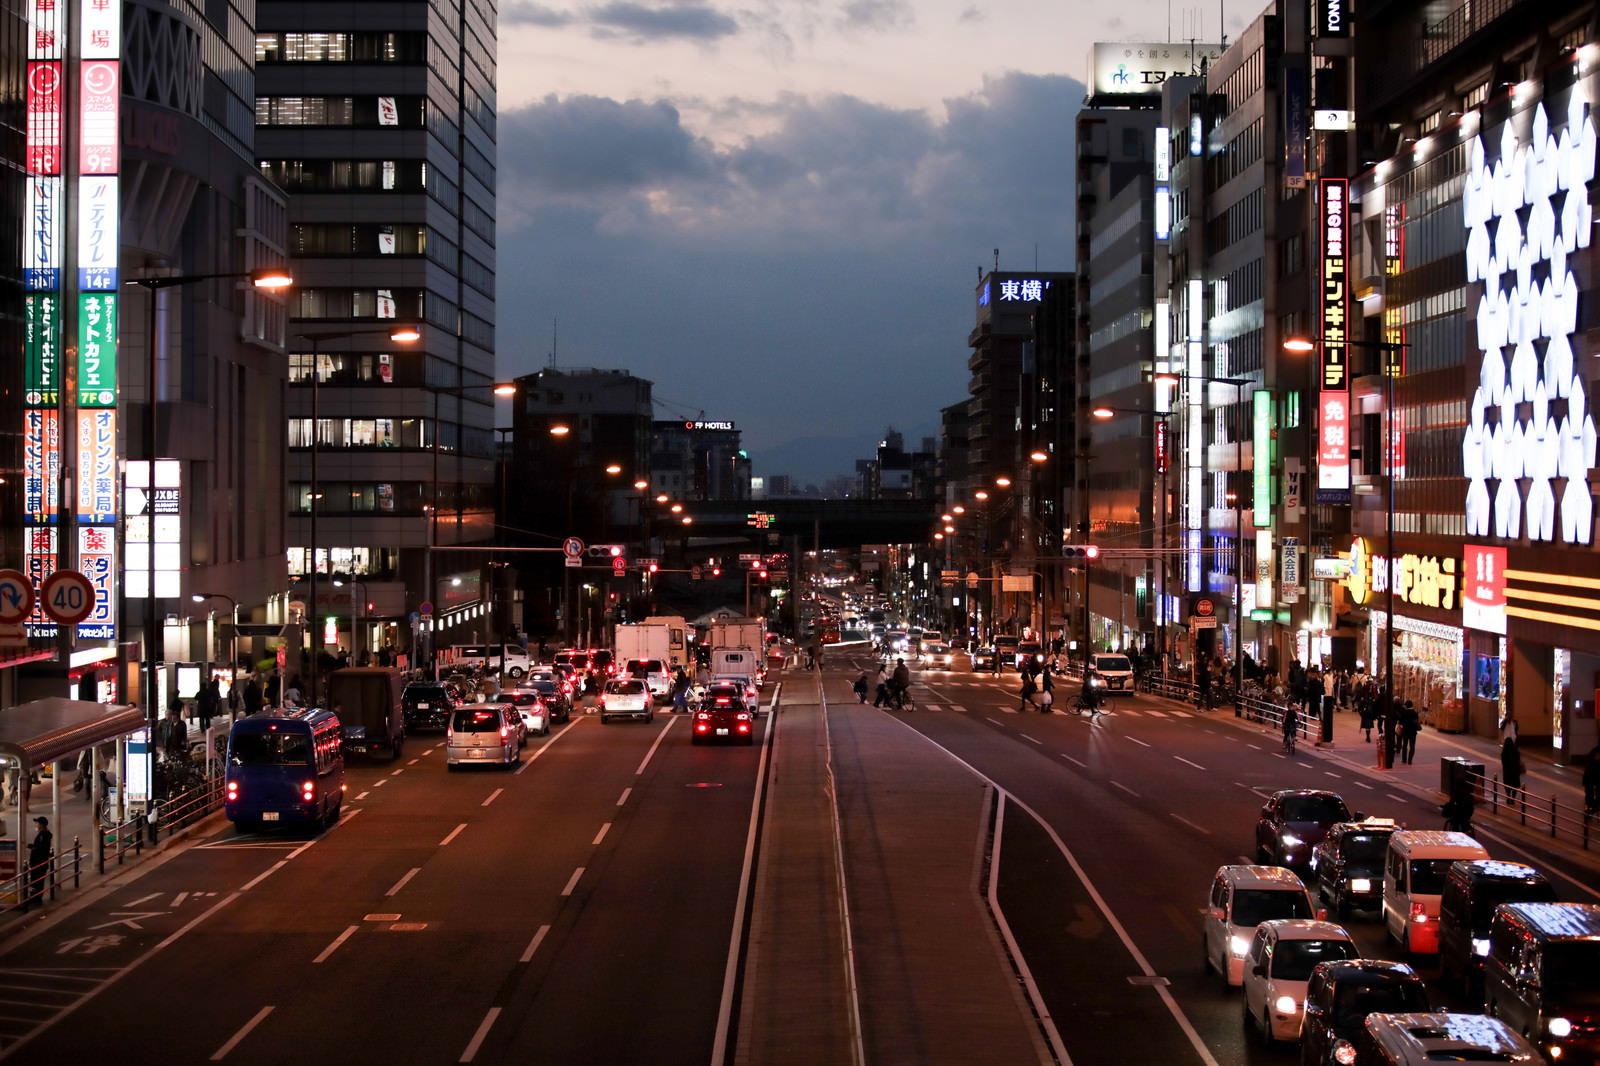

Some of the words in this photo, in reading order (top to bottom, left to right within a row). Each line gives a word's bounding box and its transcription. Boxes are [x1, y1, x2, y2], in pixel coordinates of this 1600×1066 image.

[87, 154, 111, 172] 9F
[86, 275, 110, 288] 14F
[999, 280, 1050, 302] 東横
[84, 297, 100, 385] ネットカフェ
[81, 392, 97, 403] 7F
[1324, 400, 1345, 446] 免税
[96, 412, 112, 512] オレンジ薬局
[88, 514, 104, 522] 1F
[1285, 548, 1296, 582] 英会話
[53, 586, 83, 609] 40
[95, 557, 109, 620] ダイコク
